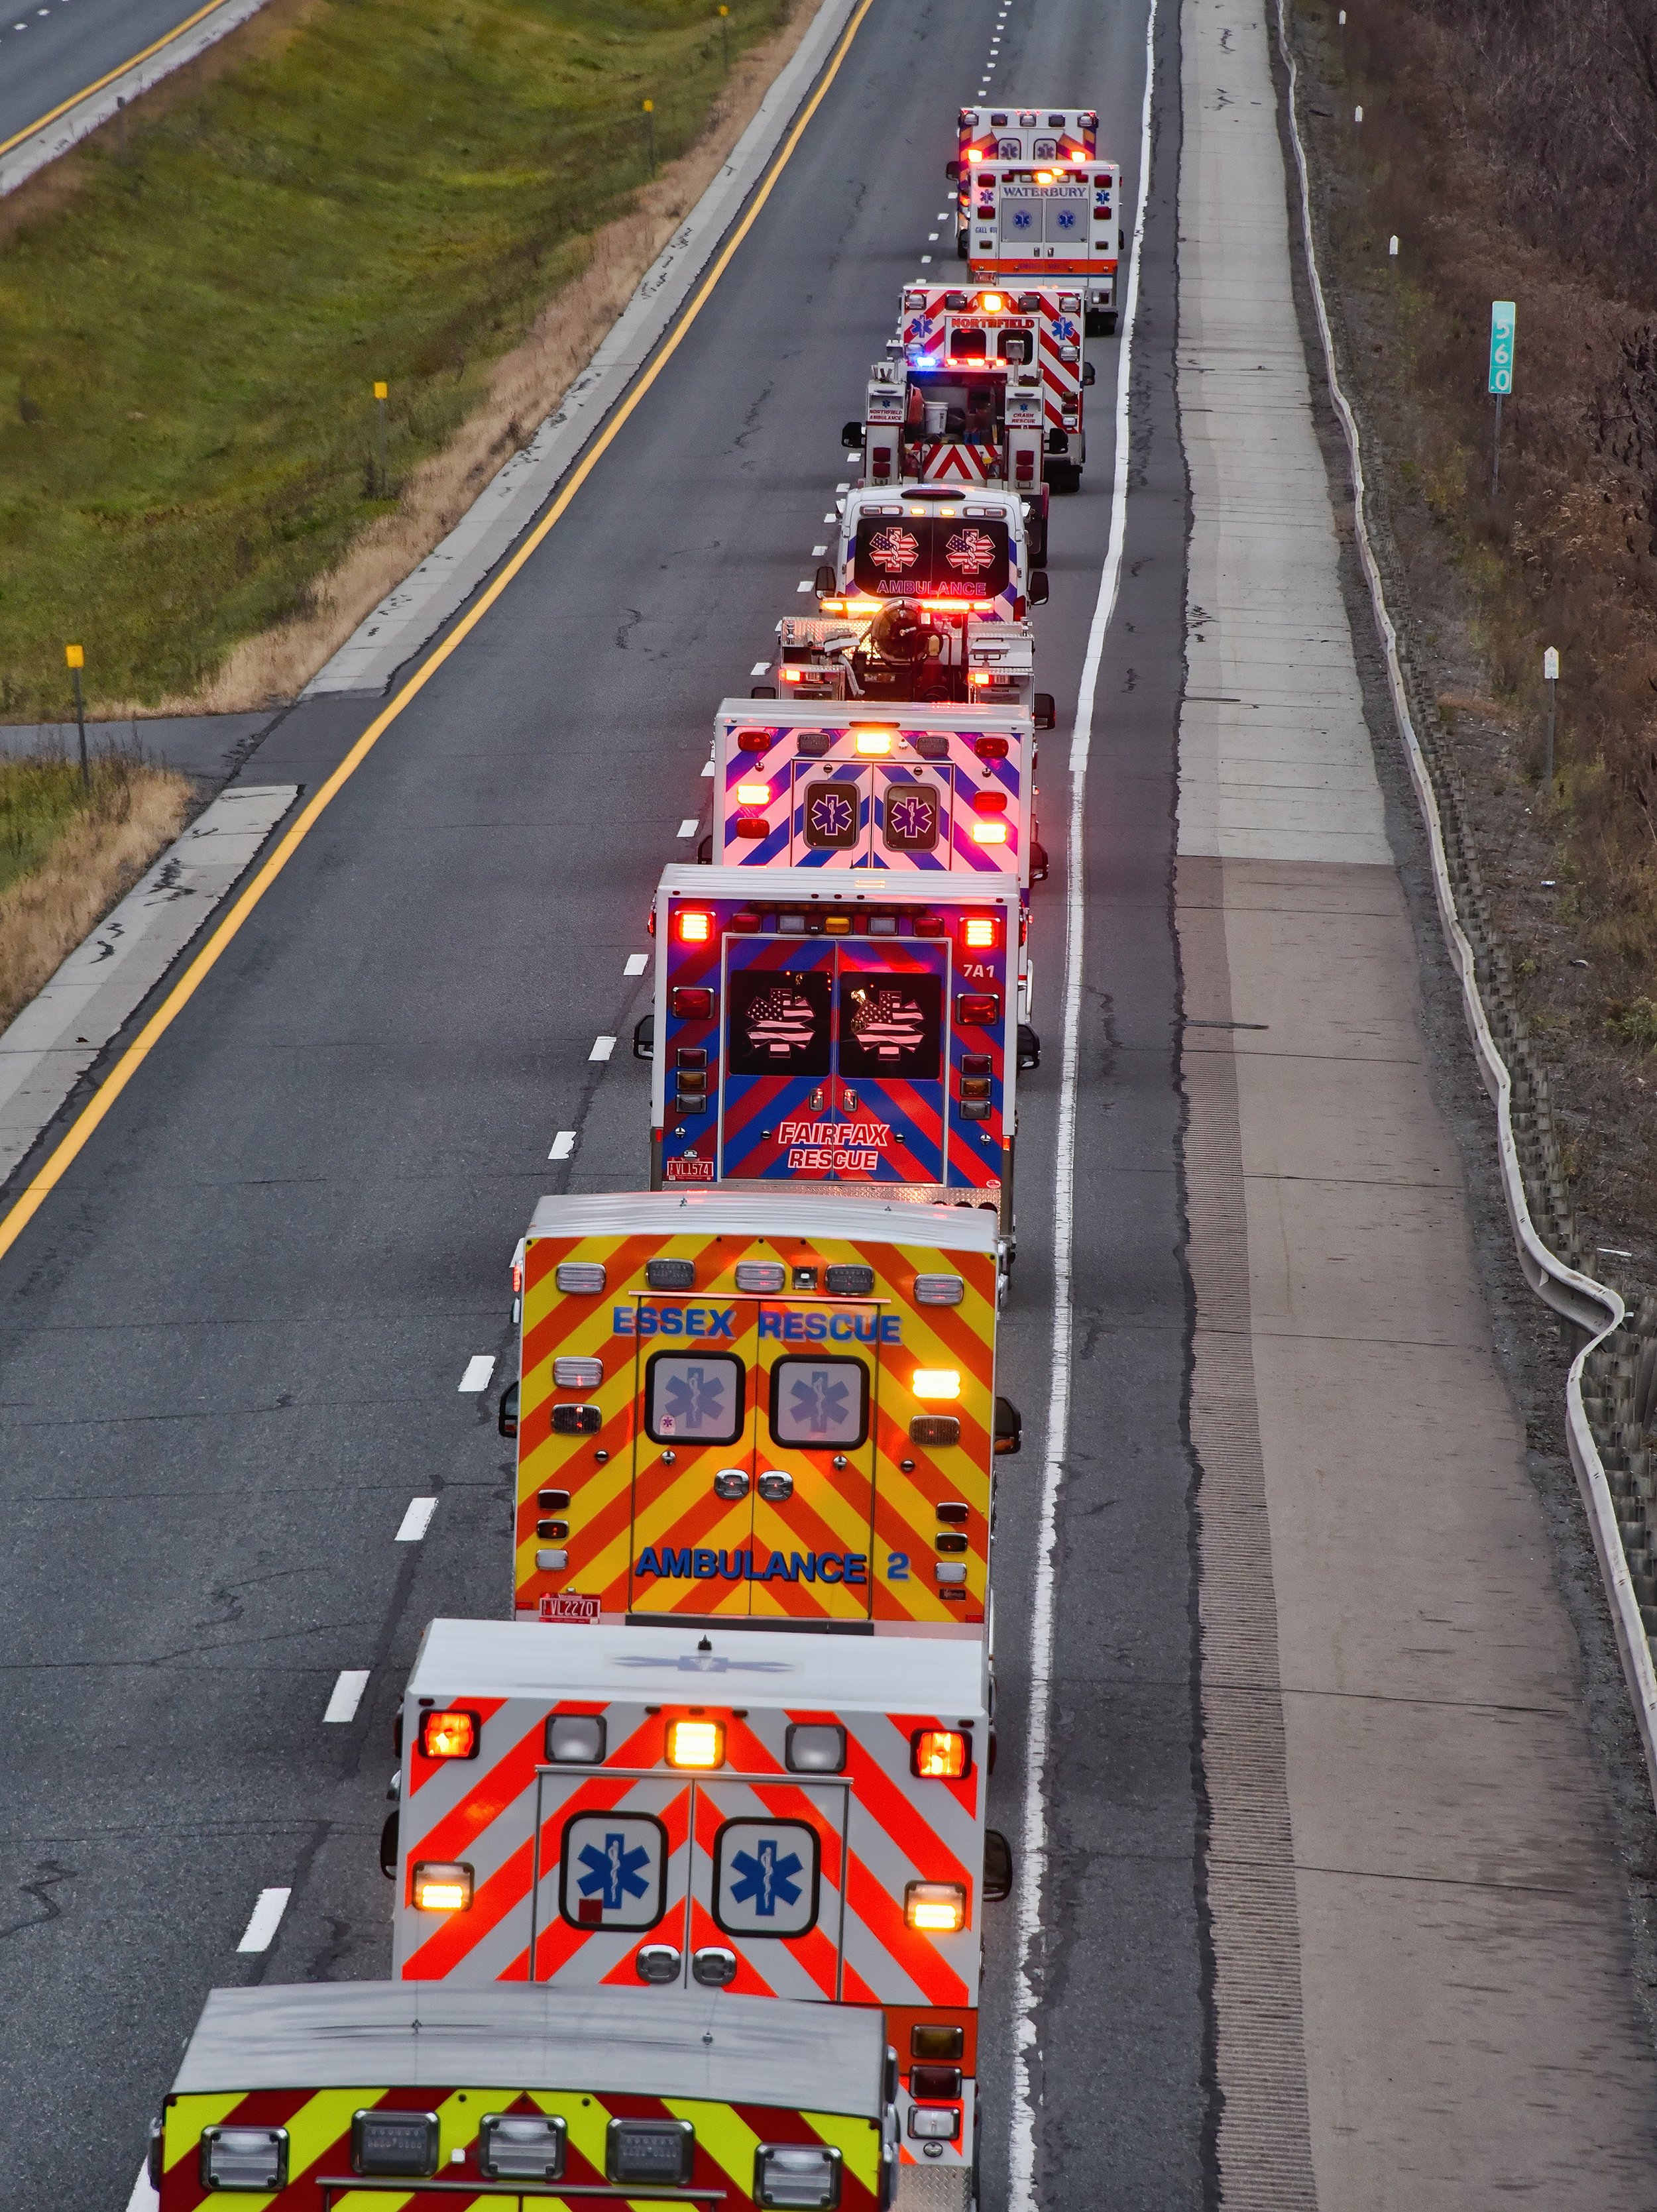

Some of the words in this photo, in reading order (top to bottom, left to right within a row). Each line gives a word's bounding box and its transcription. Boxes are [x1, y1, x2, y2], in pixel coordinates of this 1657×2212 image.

[1003, 187, 1086, 197] WATERBURY
[951, 318, 1035, 329] NORTHFIELD
[877, 580, 986, 596] AMBULANCE
[963, 964, 994, 978] 7A1
[778, 1122, 890, 1146] FAIRFAX
[788, 1150, 879, 1171] RESCUE
[676, 1163, 709, 1175] VL1574
[613, 1306, 737, 1339] ESSEX
[759, 1311, 902, 1345] RESCUE
[635, 1547, 868, 1583] AMBULANCE
[887, 1552, 911, 1581] 2
[551, 1600, 593, 1616] VL2270
